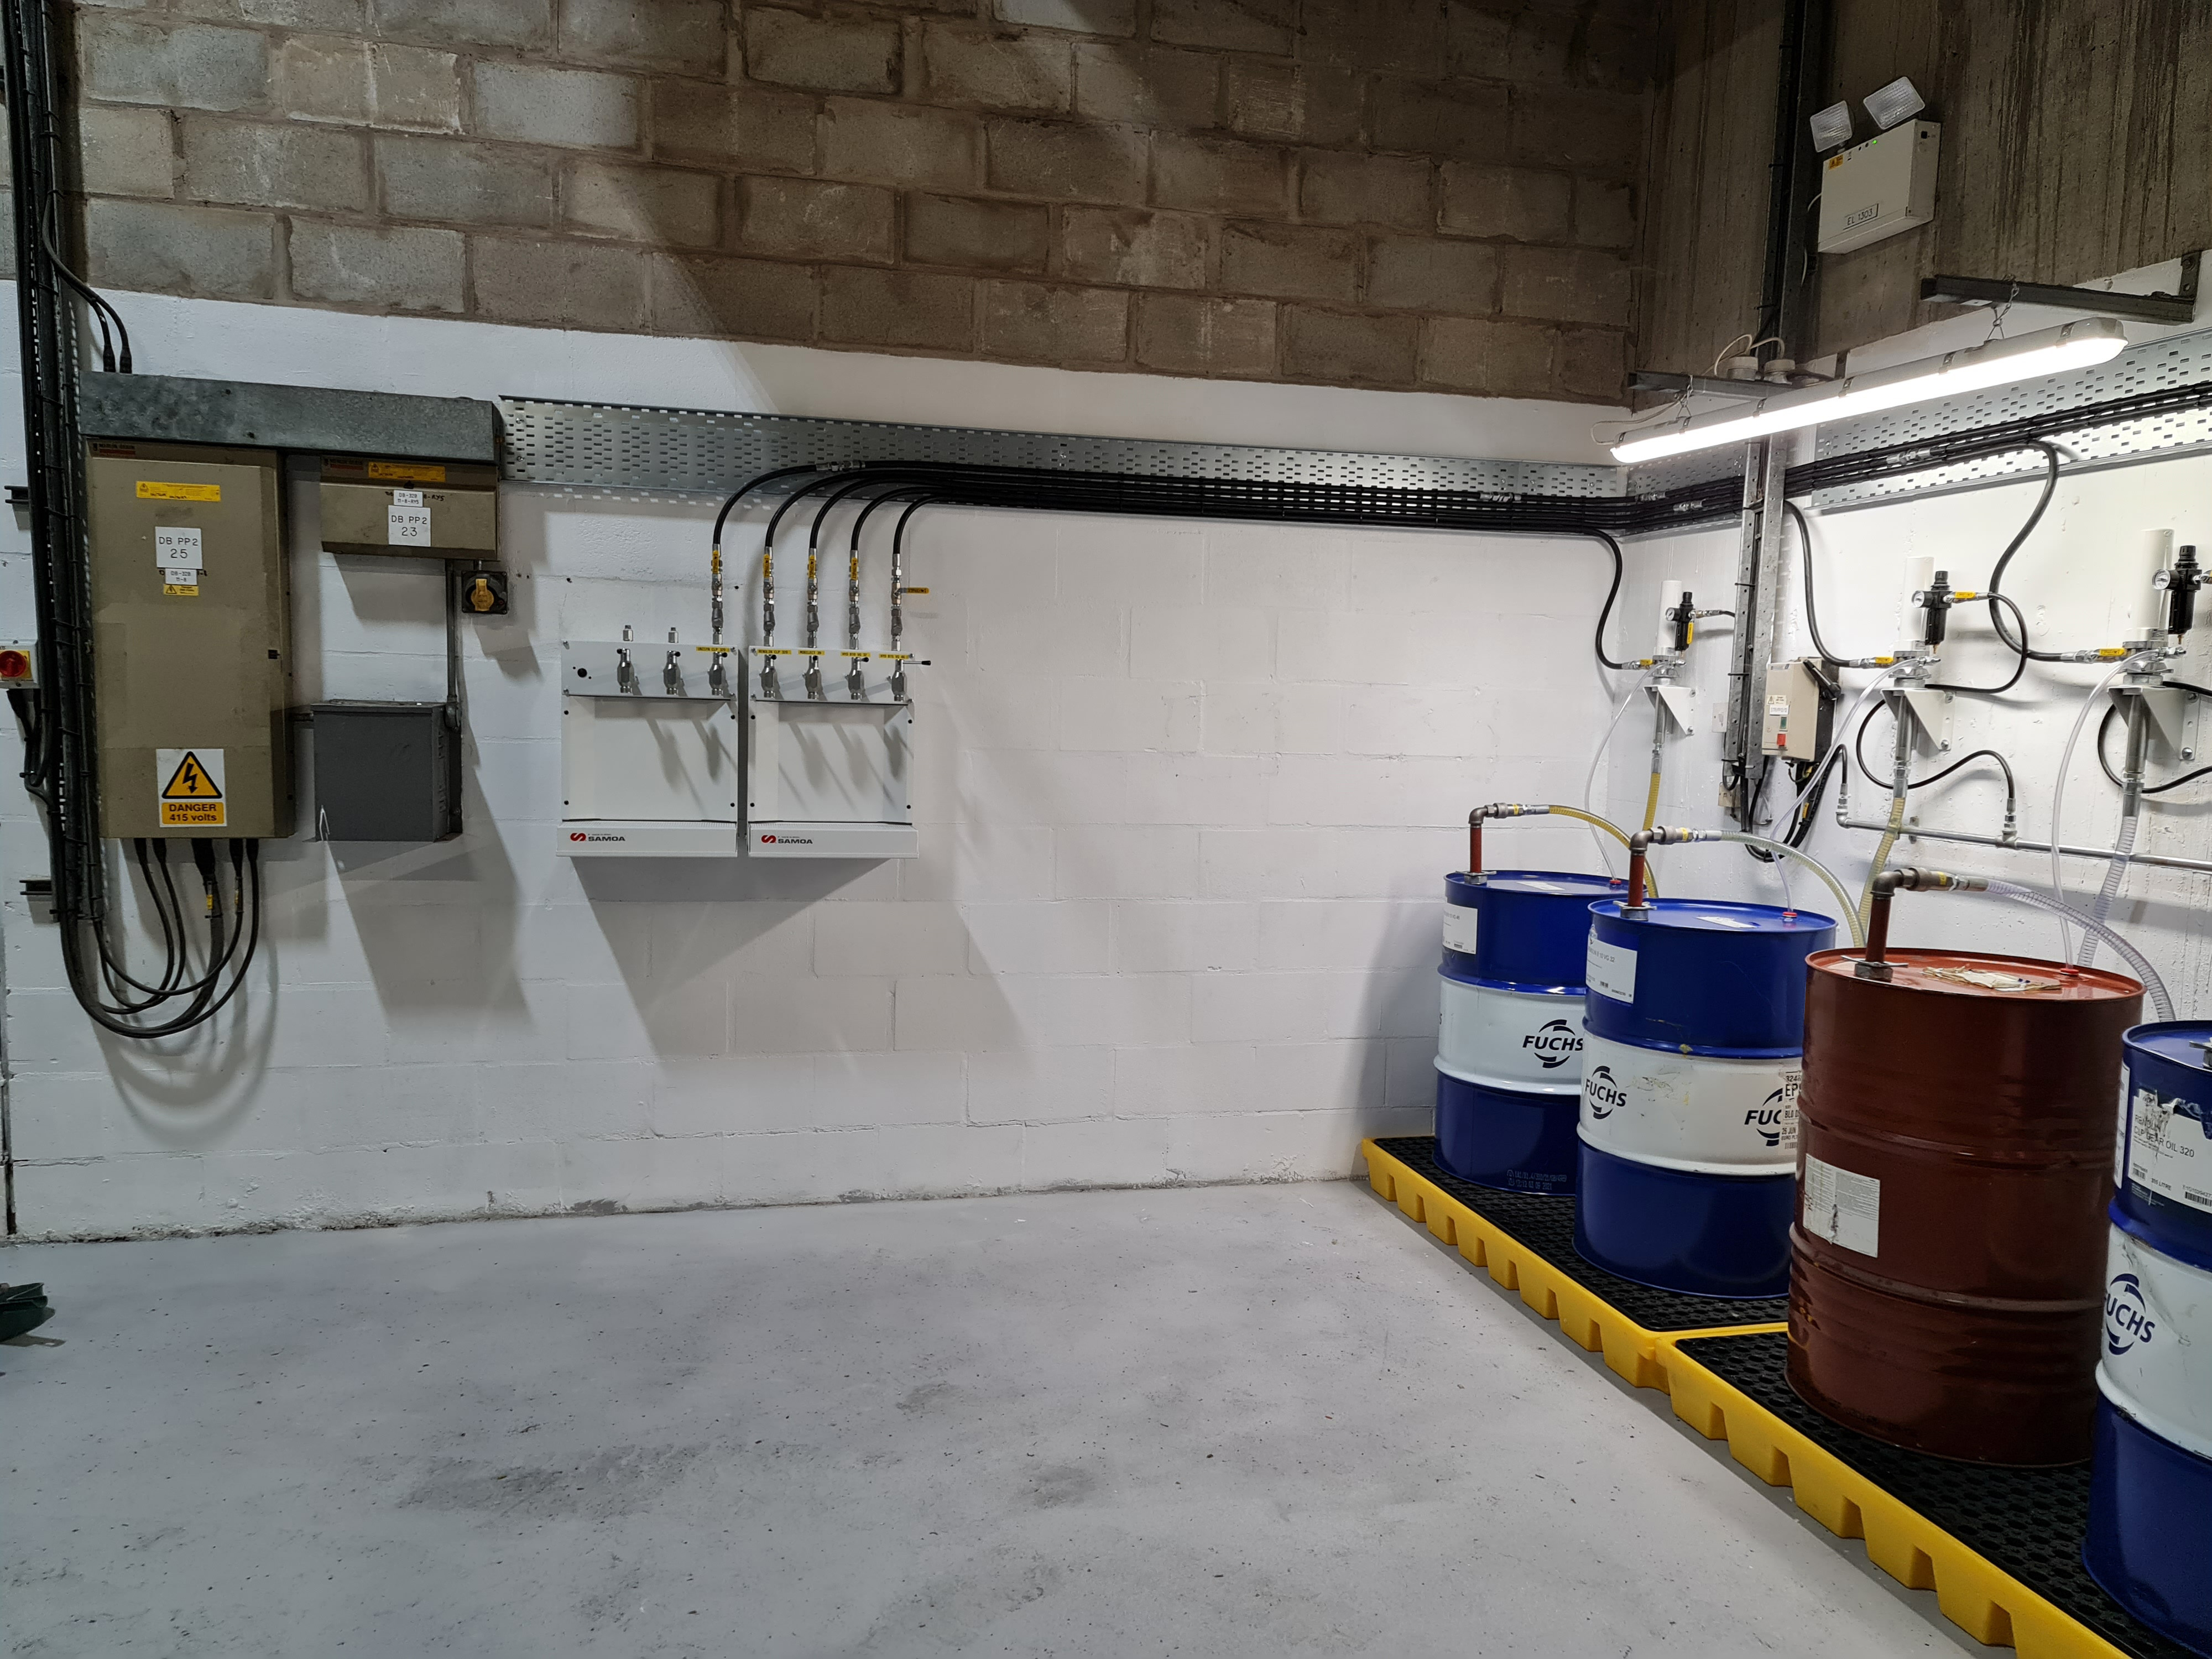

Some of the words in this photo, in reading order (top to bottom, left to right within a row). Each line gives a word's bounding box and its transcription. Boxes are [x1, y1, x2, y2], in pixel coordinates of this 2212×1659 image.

[1847, 216, 1855, 226] EL
[1858, 208, 1872, 220] 1303
[391, 515, 404, 523] DB
[401, 526, 418, 536] 23
[159, 536, 173, 545] DB
[170, 548, 188, 559] 25
[169, 804, 217, 812] DANGER
[1522, 1035, 1583, 1051] FUCHS
[1585, 1078, 1627, 1107] FUCHS
[1744, 1109, 1782, 1125] FUC
[2166, 1140, 2178, 1152] OIL
[2179, 1146, 2195, 1158] 320
[2159, 1181, 2172, 1191] LITRE
[2105, 1292, 2156, 1343] UCHS
